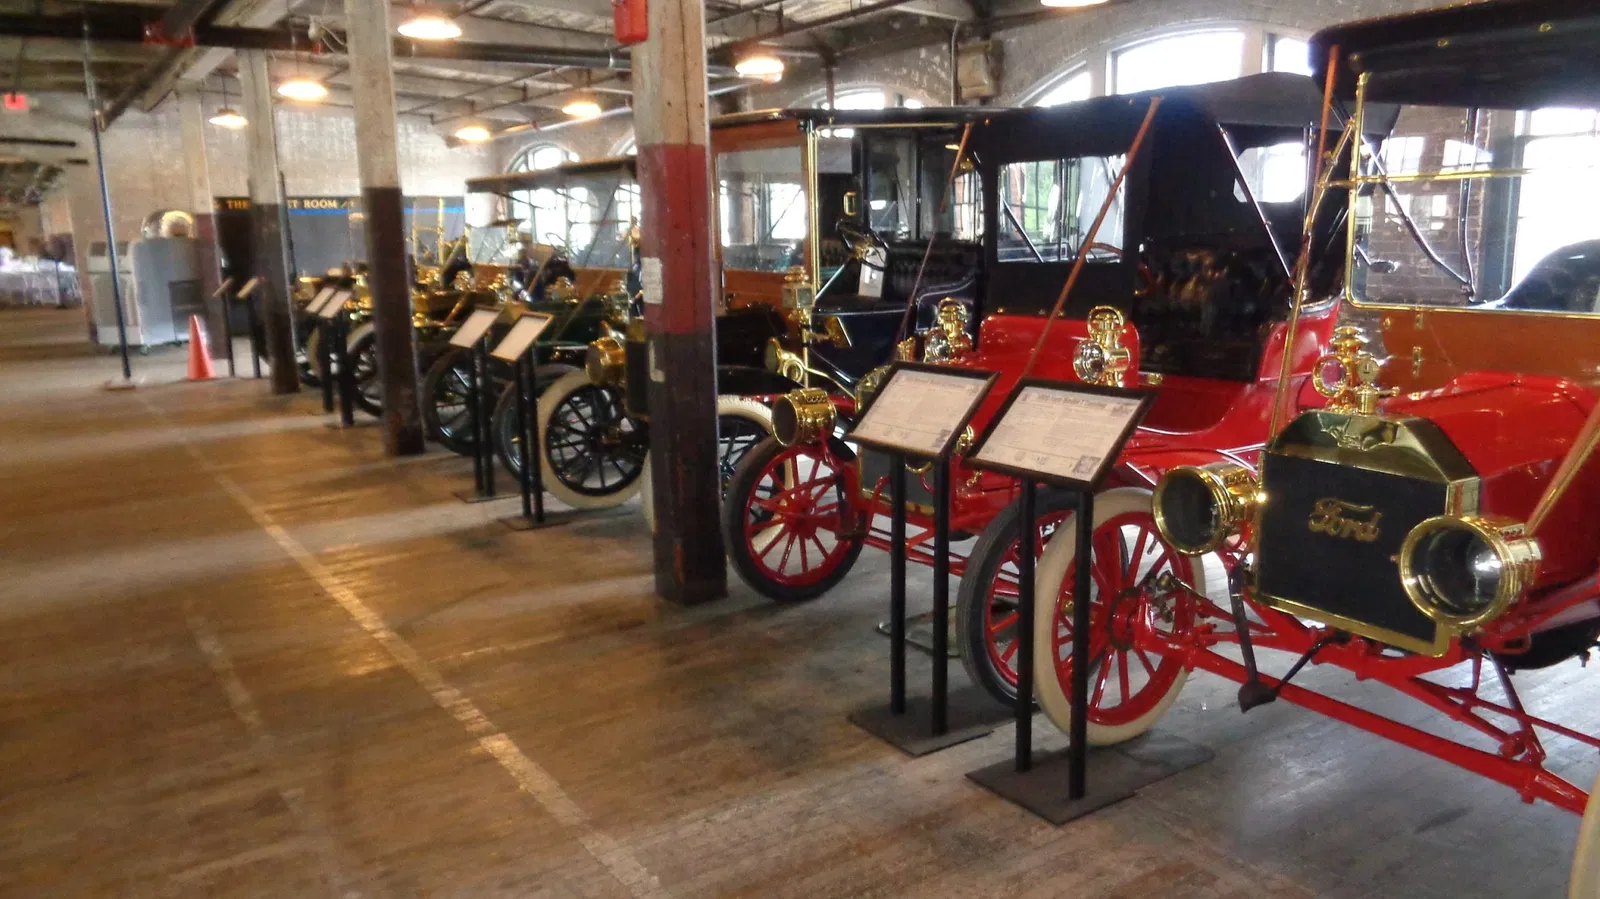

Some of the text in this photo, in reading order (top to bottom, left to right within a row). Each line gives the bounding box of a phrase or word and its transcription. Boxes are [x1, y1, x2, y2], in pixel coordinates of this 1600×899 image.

[226, 199, 250, 209] THE
[303, 199, 338, 209] ROOM
[1308, 497, 1382, 541] Ford
